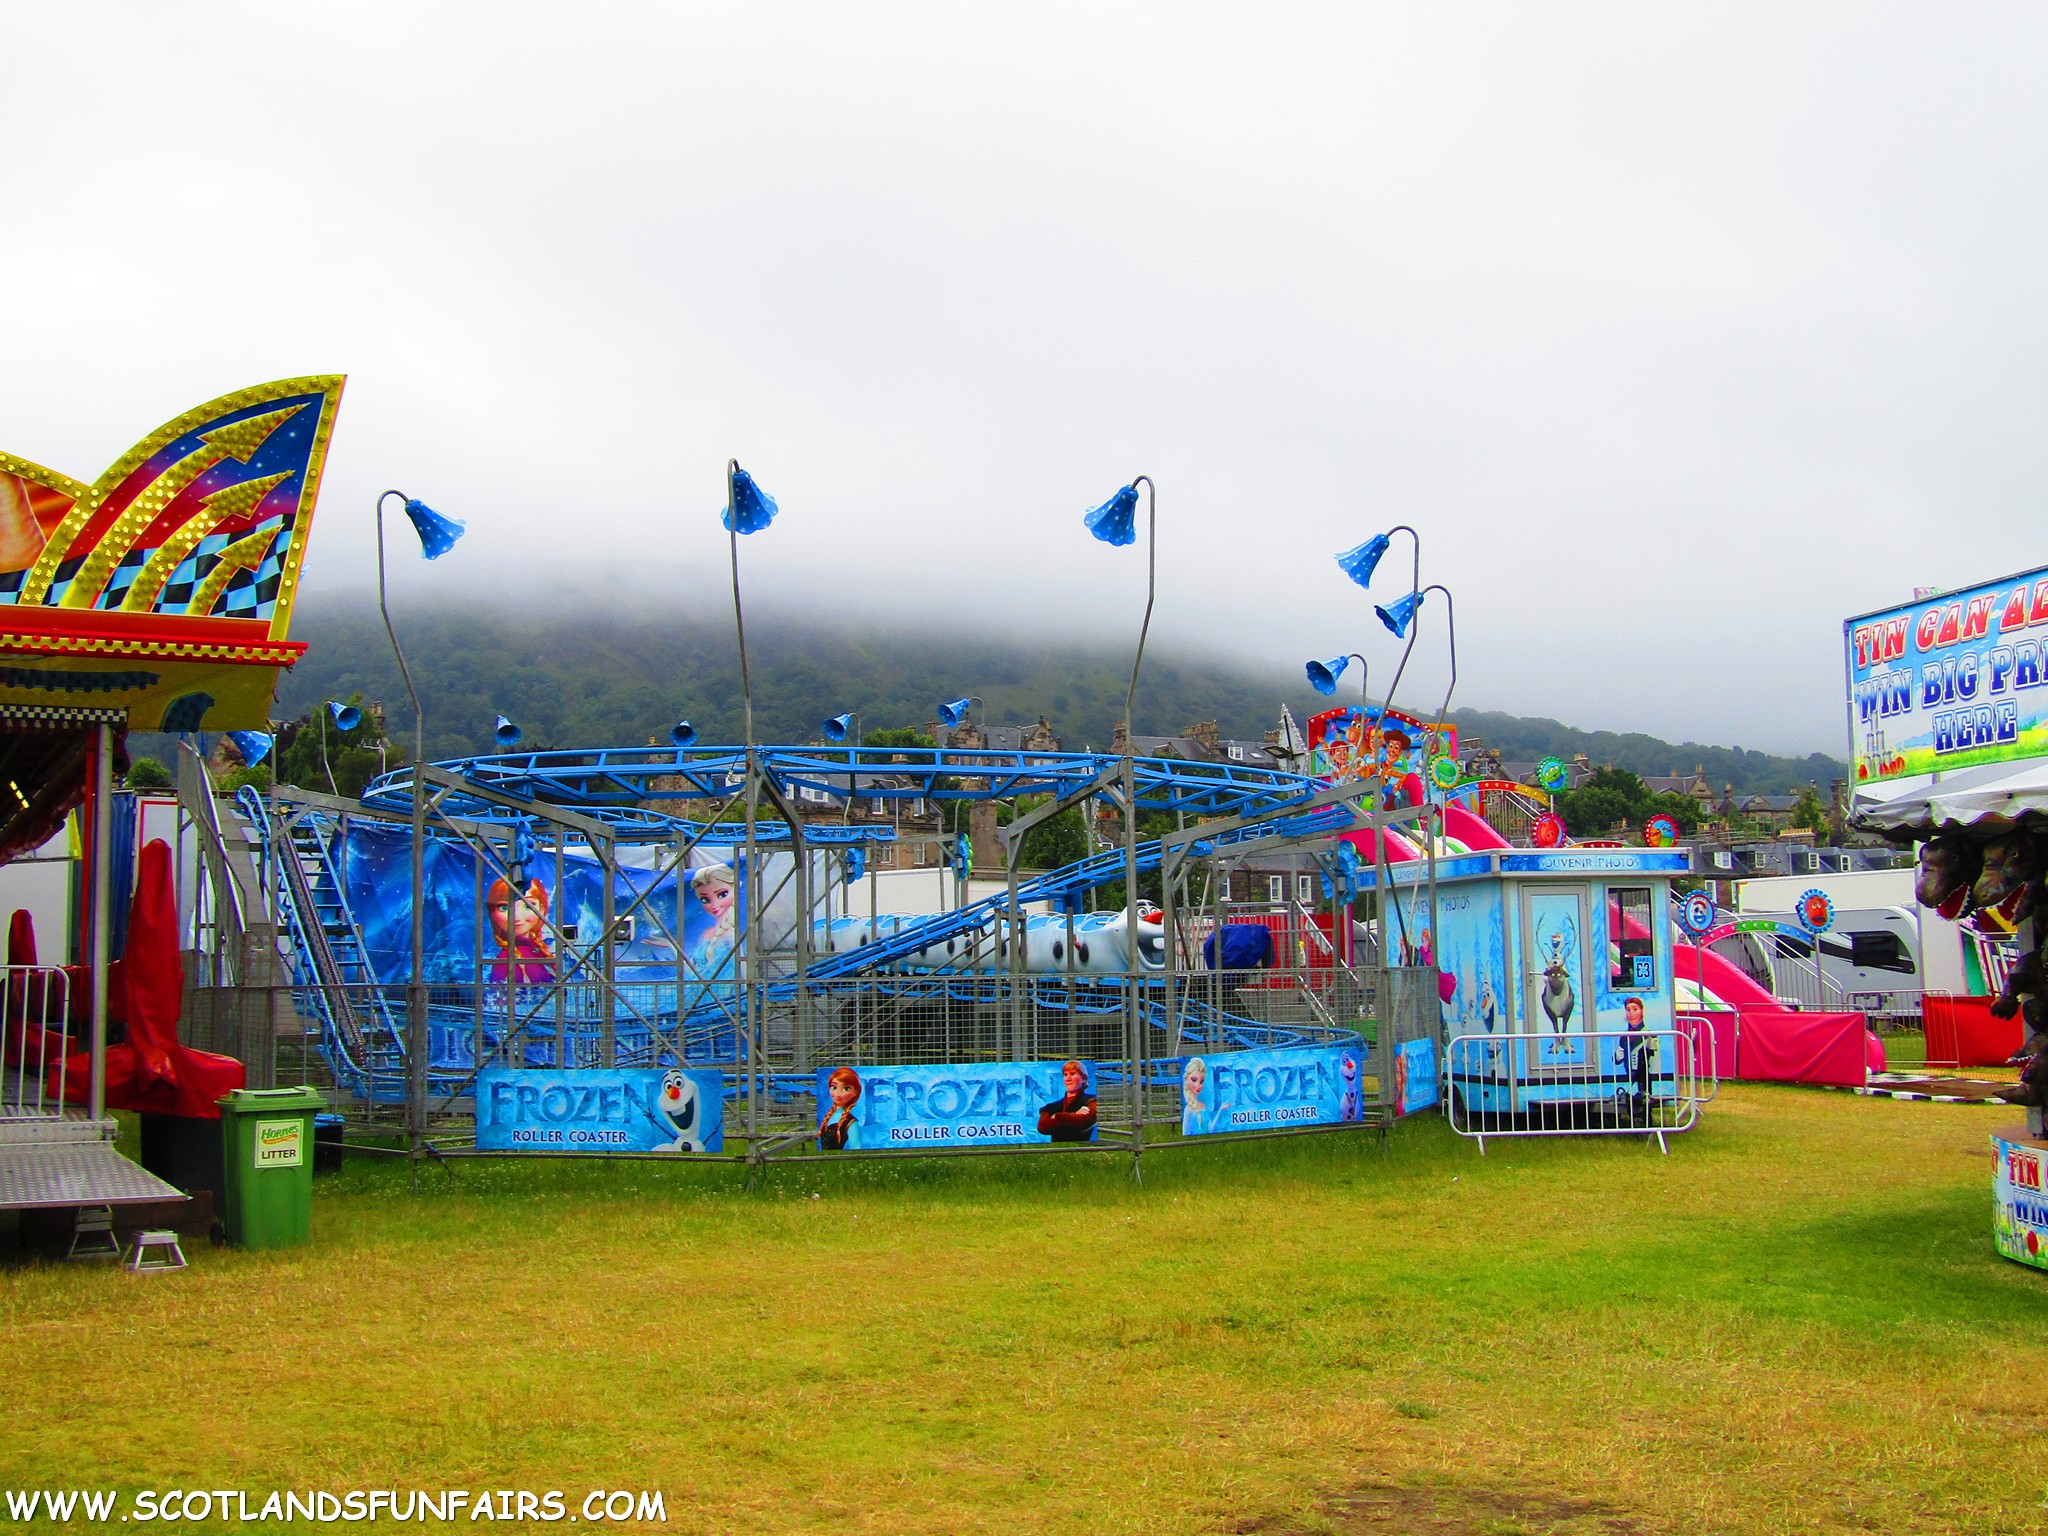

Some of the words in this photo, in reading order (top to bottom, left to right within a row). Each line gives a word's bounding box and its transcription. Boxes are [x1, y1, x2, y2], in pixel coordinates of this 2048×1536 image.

[1854, 614, 1911, 670] TIN
[1916, 591, 1997, 654] CAN
[1857, 667, 1913, 722] WIN
[1922, 651, 1980, 709] BIG
[1933, 697, 2019, 757] HERE
[1540, 858, 1593, 868] SOUVENIR
[1598, 857, 1640, 868] PHOTOS
[1636, 962, 1650, 978] £3
[489, 1077, 655, 1126] FROZEN
[863, 1071, 1060, 1127] FROZEN
[1211, 1058, 1341, 1113] FROZEN
[512, 1129, 564, 1143] ROLLER
[568, 1130, 629, 1144] COASTER
[891, 1125, 951, 1140] ROLLER
[957, 1123, 1024, 1138] COASTER
[1231, 1110, 1271, 1124] ROLLER
[1275, 1106, 1318, 1120] COASTER
[261, 1149, 296, 1160] LITTER
[2008, 1148, 2041, 1191] TIN
